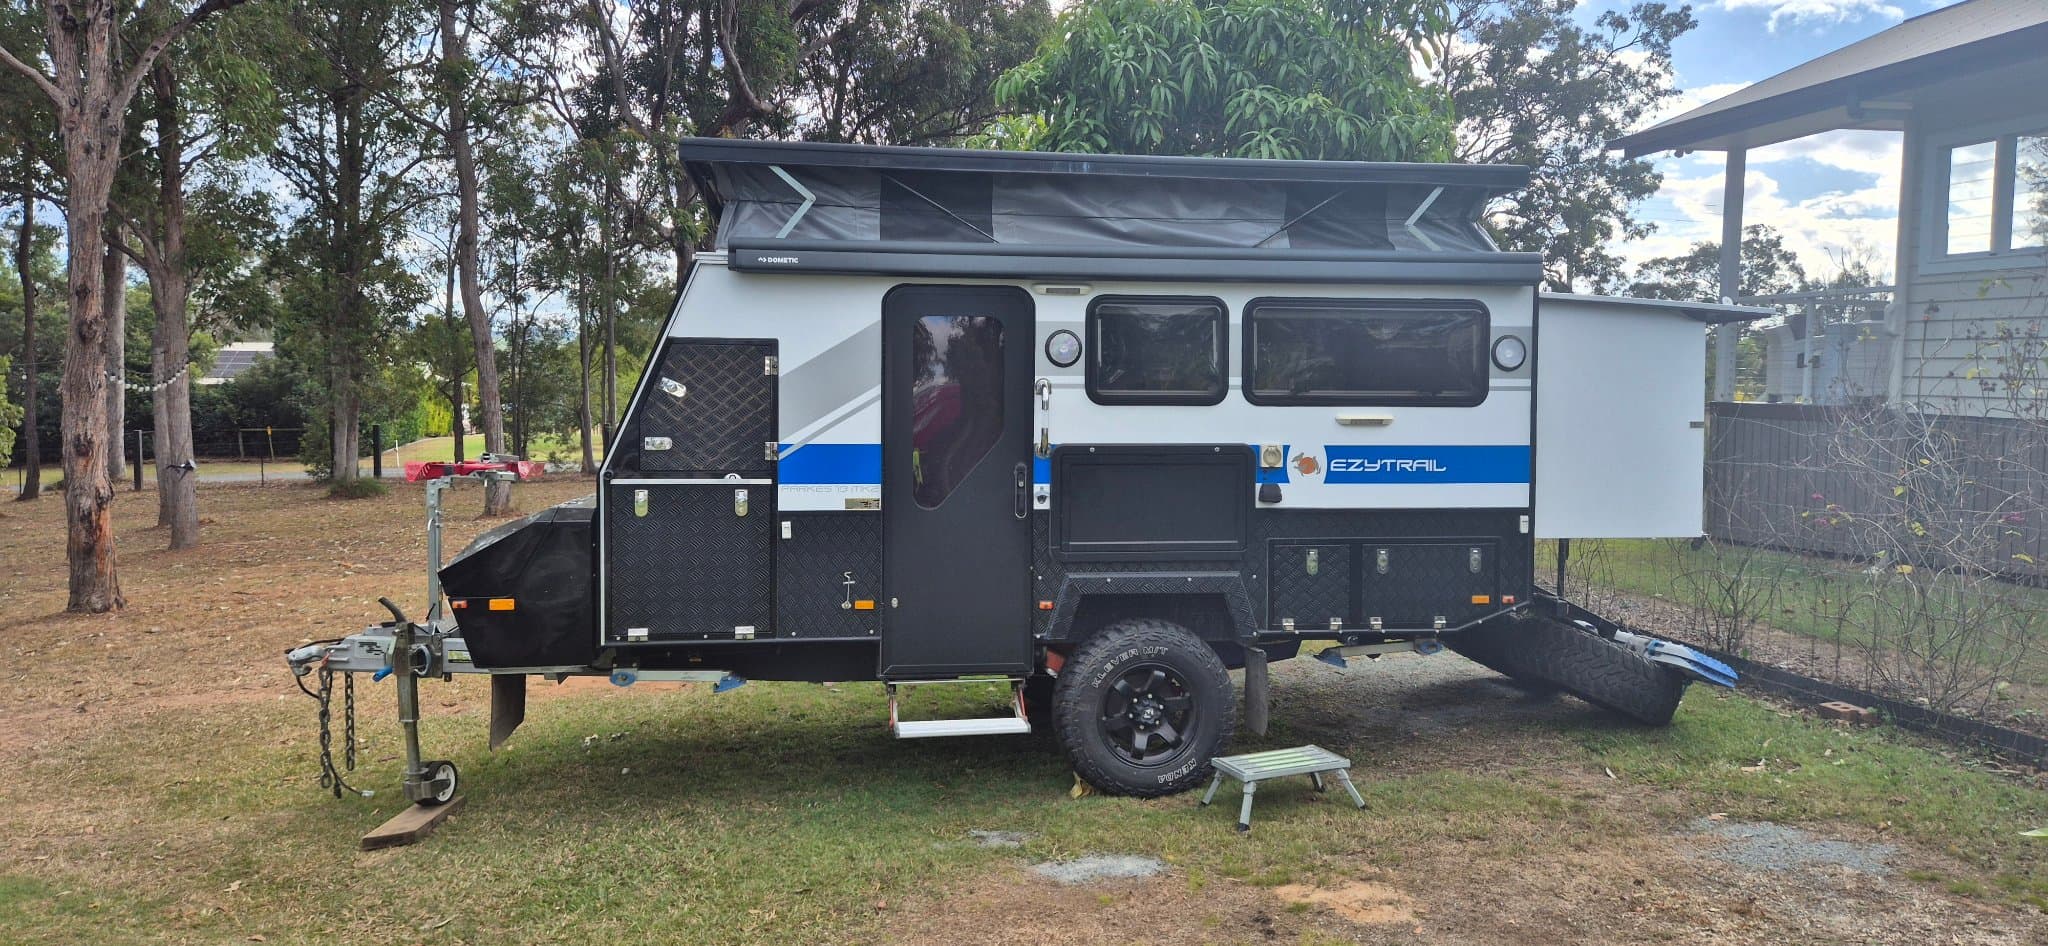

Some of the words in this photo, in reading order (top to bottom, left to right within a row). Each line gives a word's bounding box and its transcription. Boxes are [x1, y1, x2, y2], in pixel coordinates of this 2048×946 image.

[1330, 458, 1446, 472] EZYTRAIL
[1093, 648, 1139, 688] KLEVER
[1143, 646, 1169, 657] M/T
[1157, 758, 1197, 784] KENDA
